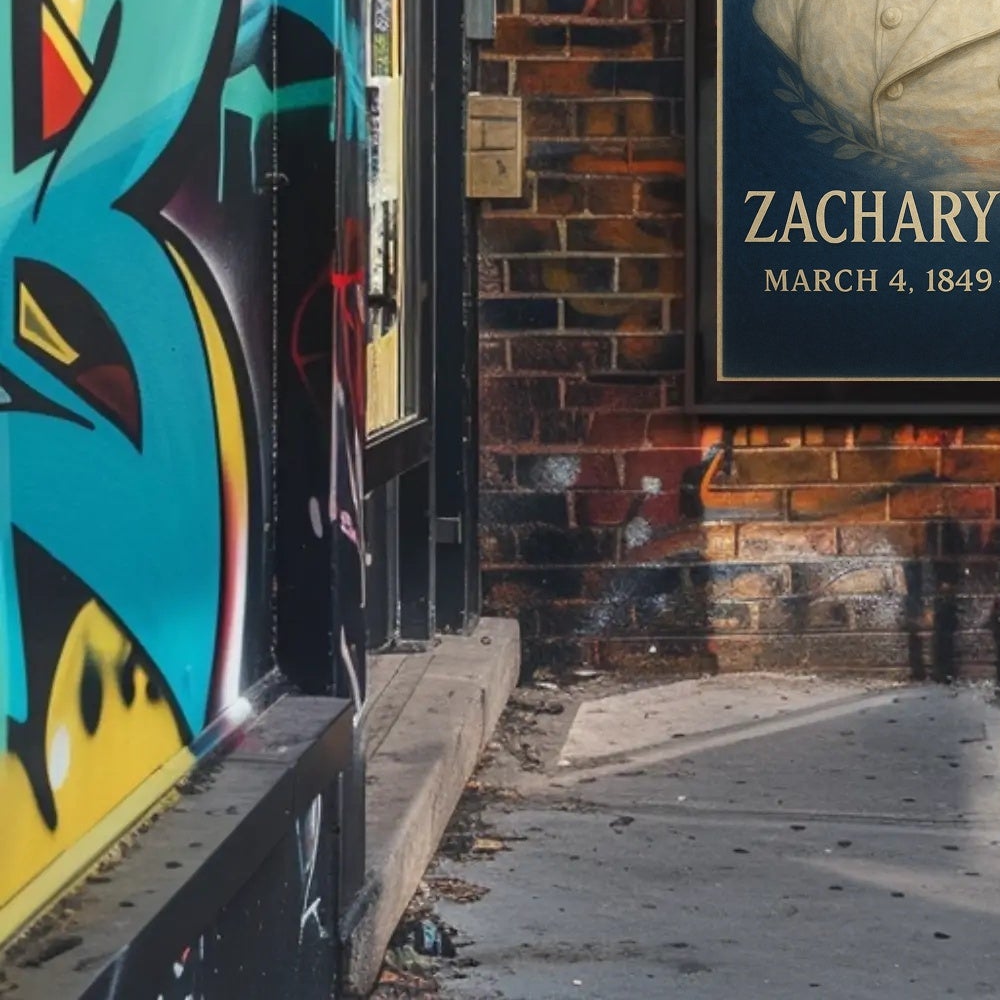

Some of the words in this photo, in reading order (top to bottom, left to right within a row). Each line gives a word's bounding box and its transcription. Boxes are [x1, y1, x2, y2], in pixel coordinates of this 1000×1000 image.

[744, 190, 1000, 243] ZACHARY
[764, 269, 879, 293] MARCH
[888, 269, 914, 295] 4,
